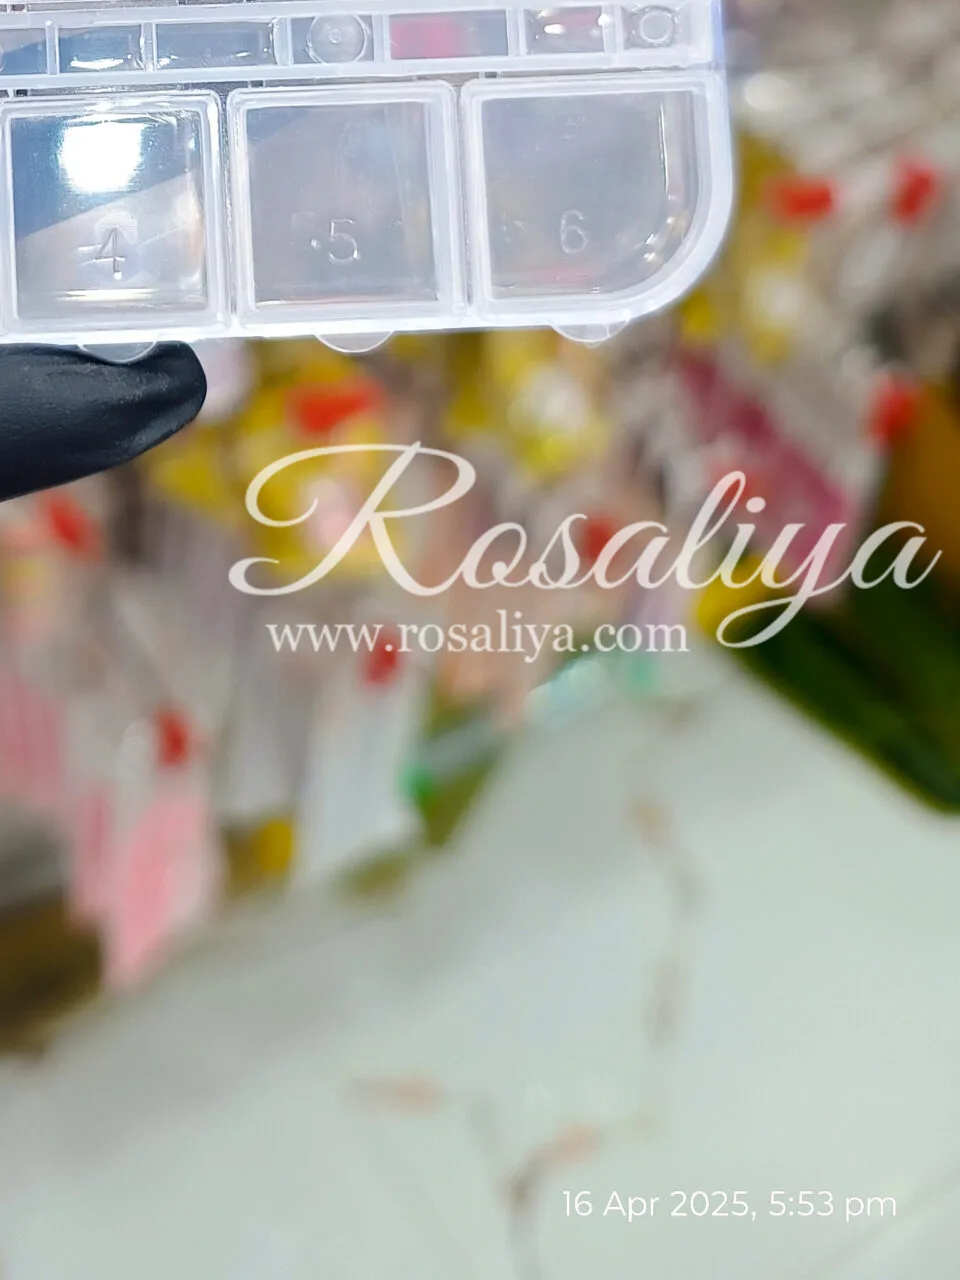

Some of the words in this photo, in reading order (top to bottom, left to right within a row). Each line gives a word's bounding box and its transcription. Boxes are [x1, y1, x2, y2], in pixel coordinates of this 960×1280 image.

[93, 226, 128, 281] 4
[327, 218, 360, 265] 5
[559, 209, 588, 255] 6
